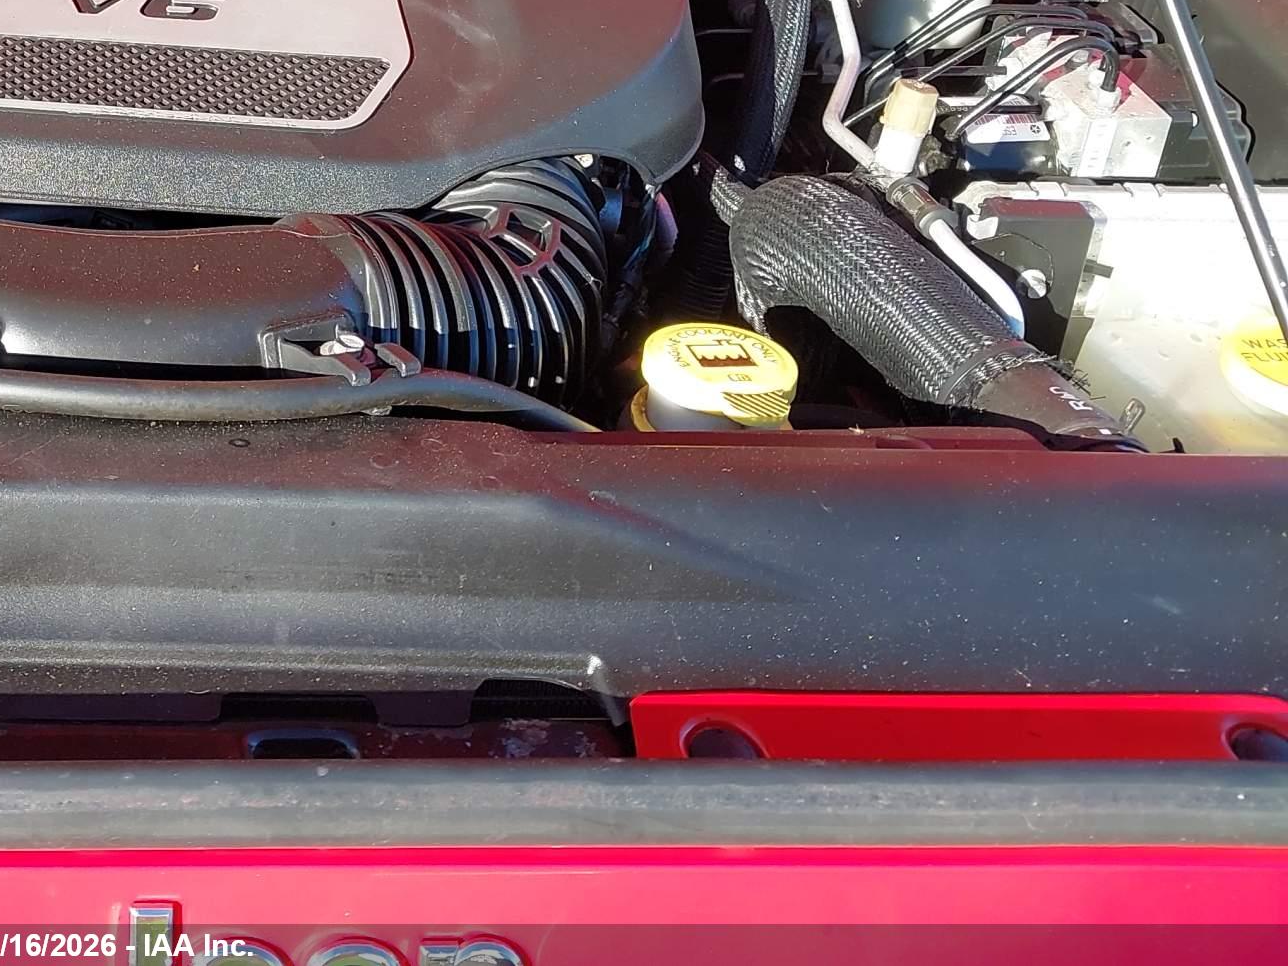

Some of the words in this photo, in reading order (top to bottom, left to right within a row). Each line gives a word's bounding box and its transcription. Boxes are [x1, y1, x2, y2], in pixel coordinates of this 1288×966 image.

[677, 328, 751, 341] COOLANT
[667, 337, 691, 368] ENGINE
[751, 341, 777, 363] ONLY
[1241, 352, 1288, 362] FLUI
